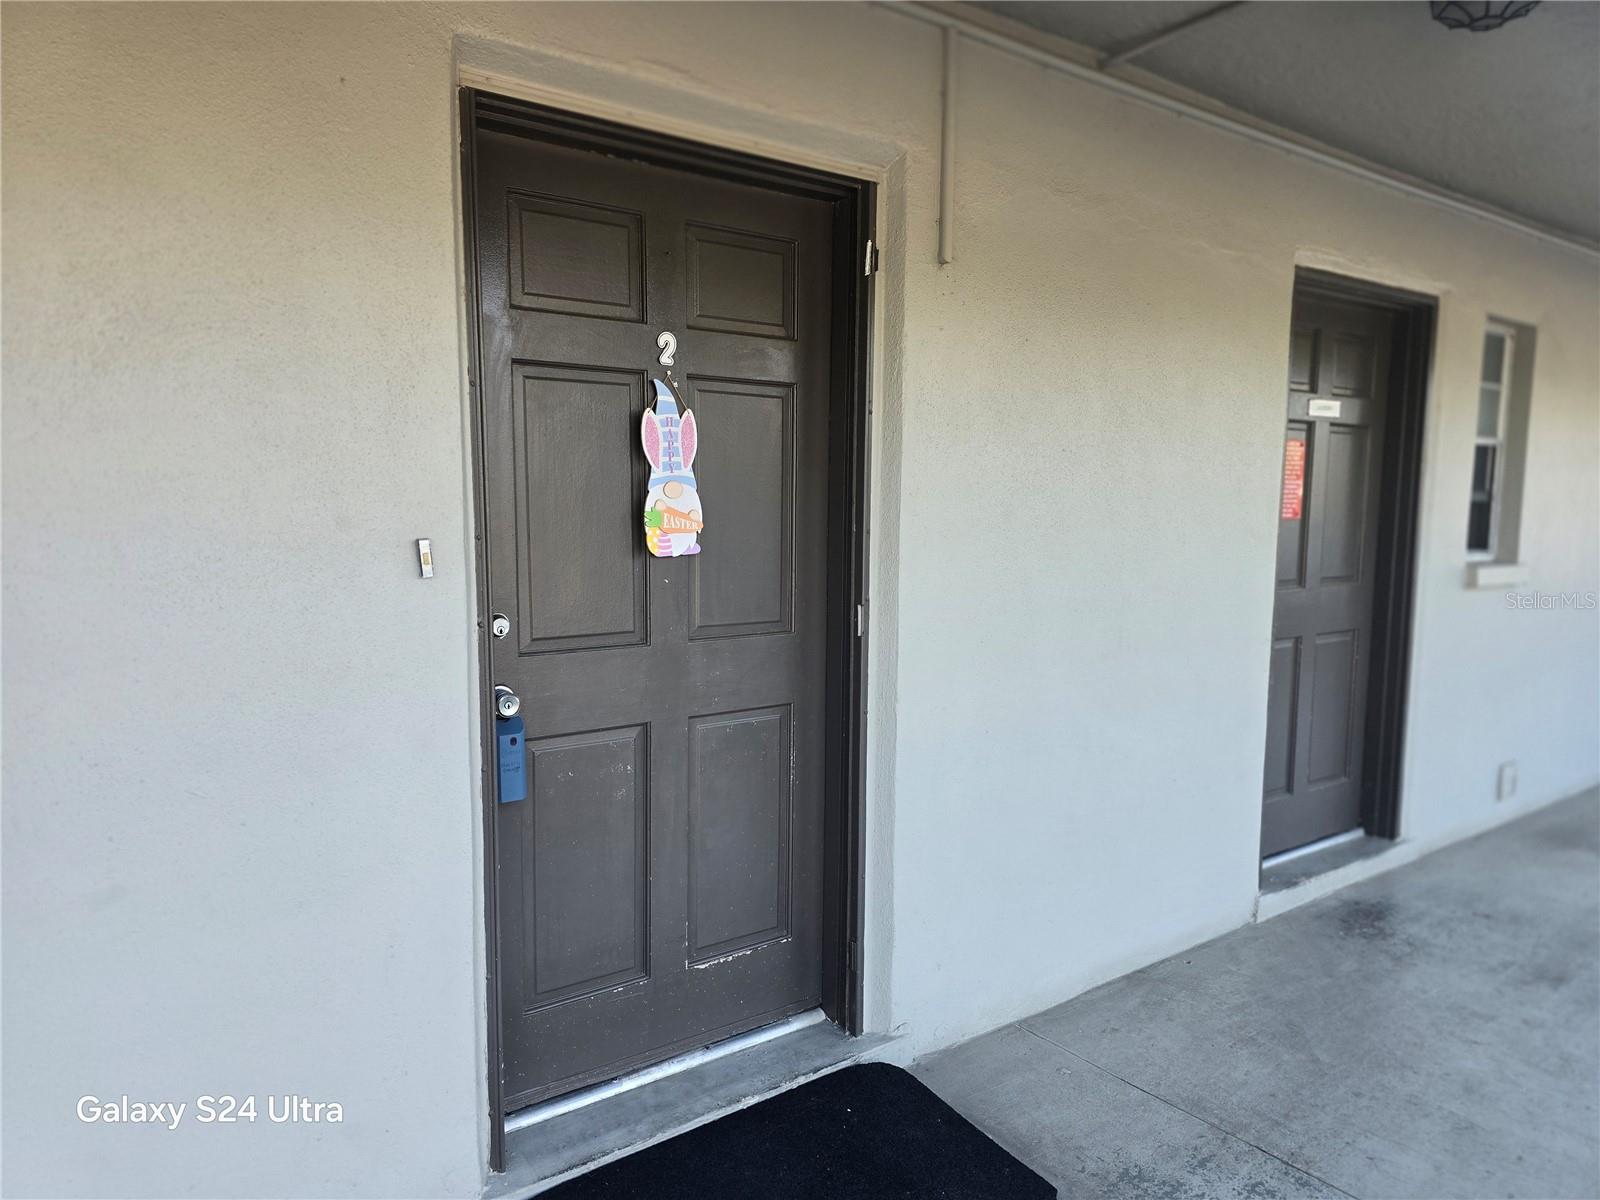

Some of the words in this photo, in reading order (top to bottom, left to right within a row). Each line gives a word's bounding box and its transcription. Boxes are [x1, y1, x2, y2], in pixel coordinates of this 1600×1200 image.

[657, 331, 677, 366] 2
[665, 416, 675, 474] HAPPY
[663, 512, 699, 530] EASTER
